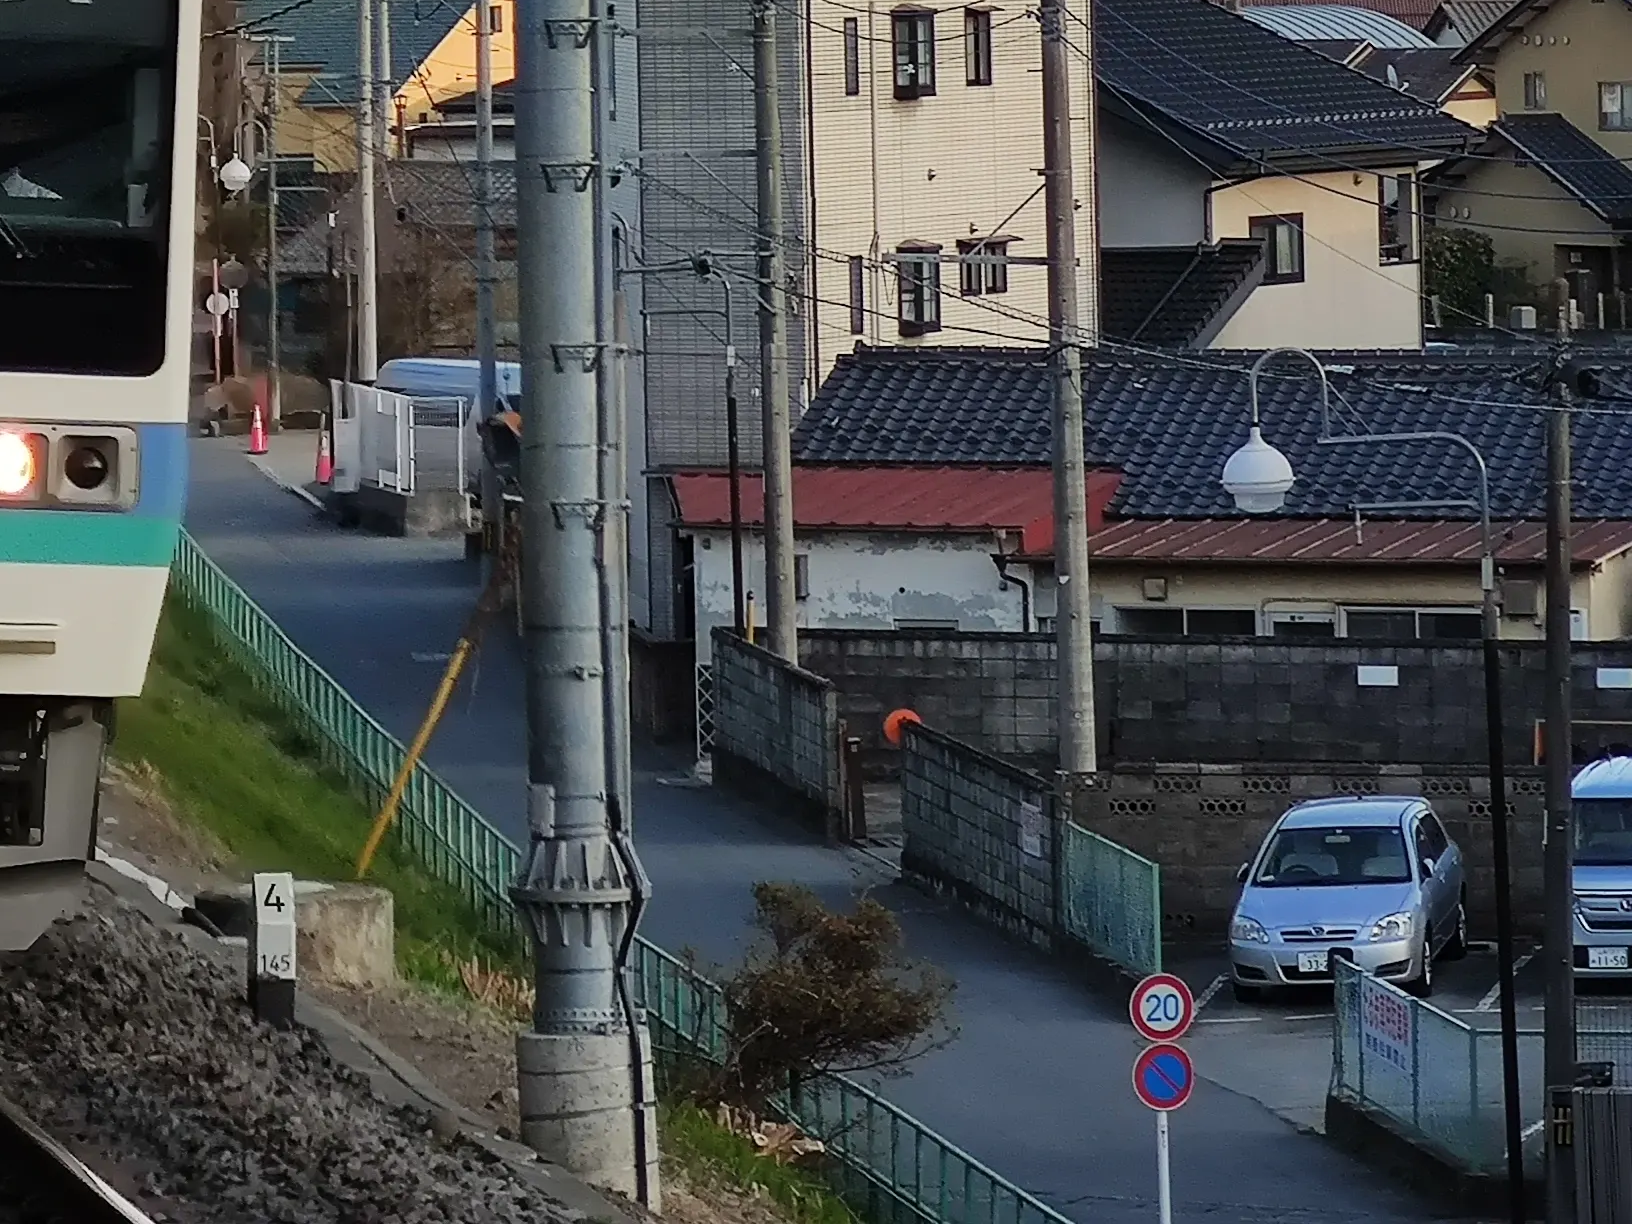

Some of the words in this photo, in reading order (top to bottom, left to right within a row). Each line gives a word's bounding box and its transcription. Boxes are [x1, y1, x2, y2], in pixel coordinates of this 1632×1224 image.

[264, 883, 285, 912] 4
[261, 954, 290, 972] 145
[1145, 993, 1179, 1022] 20
